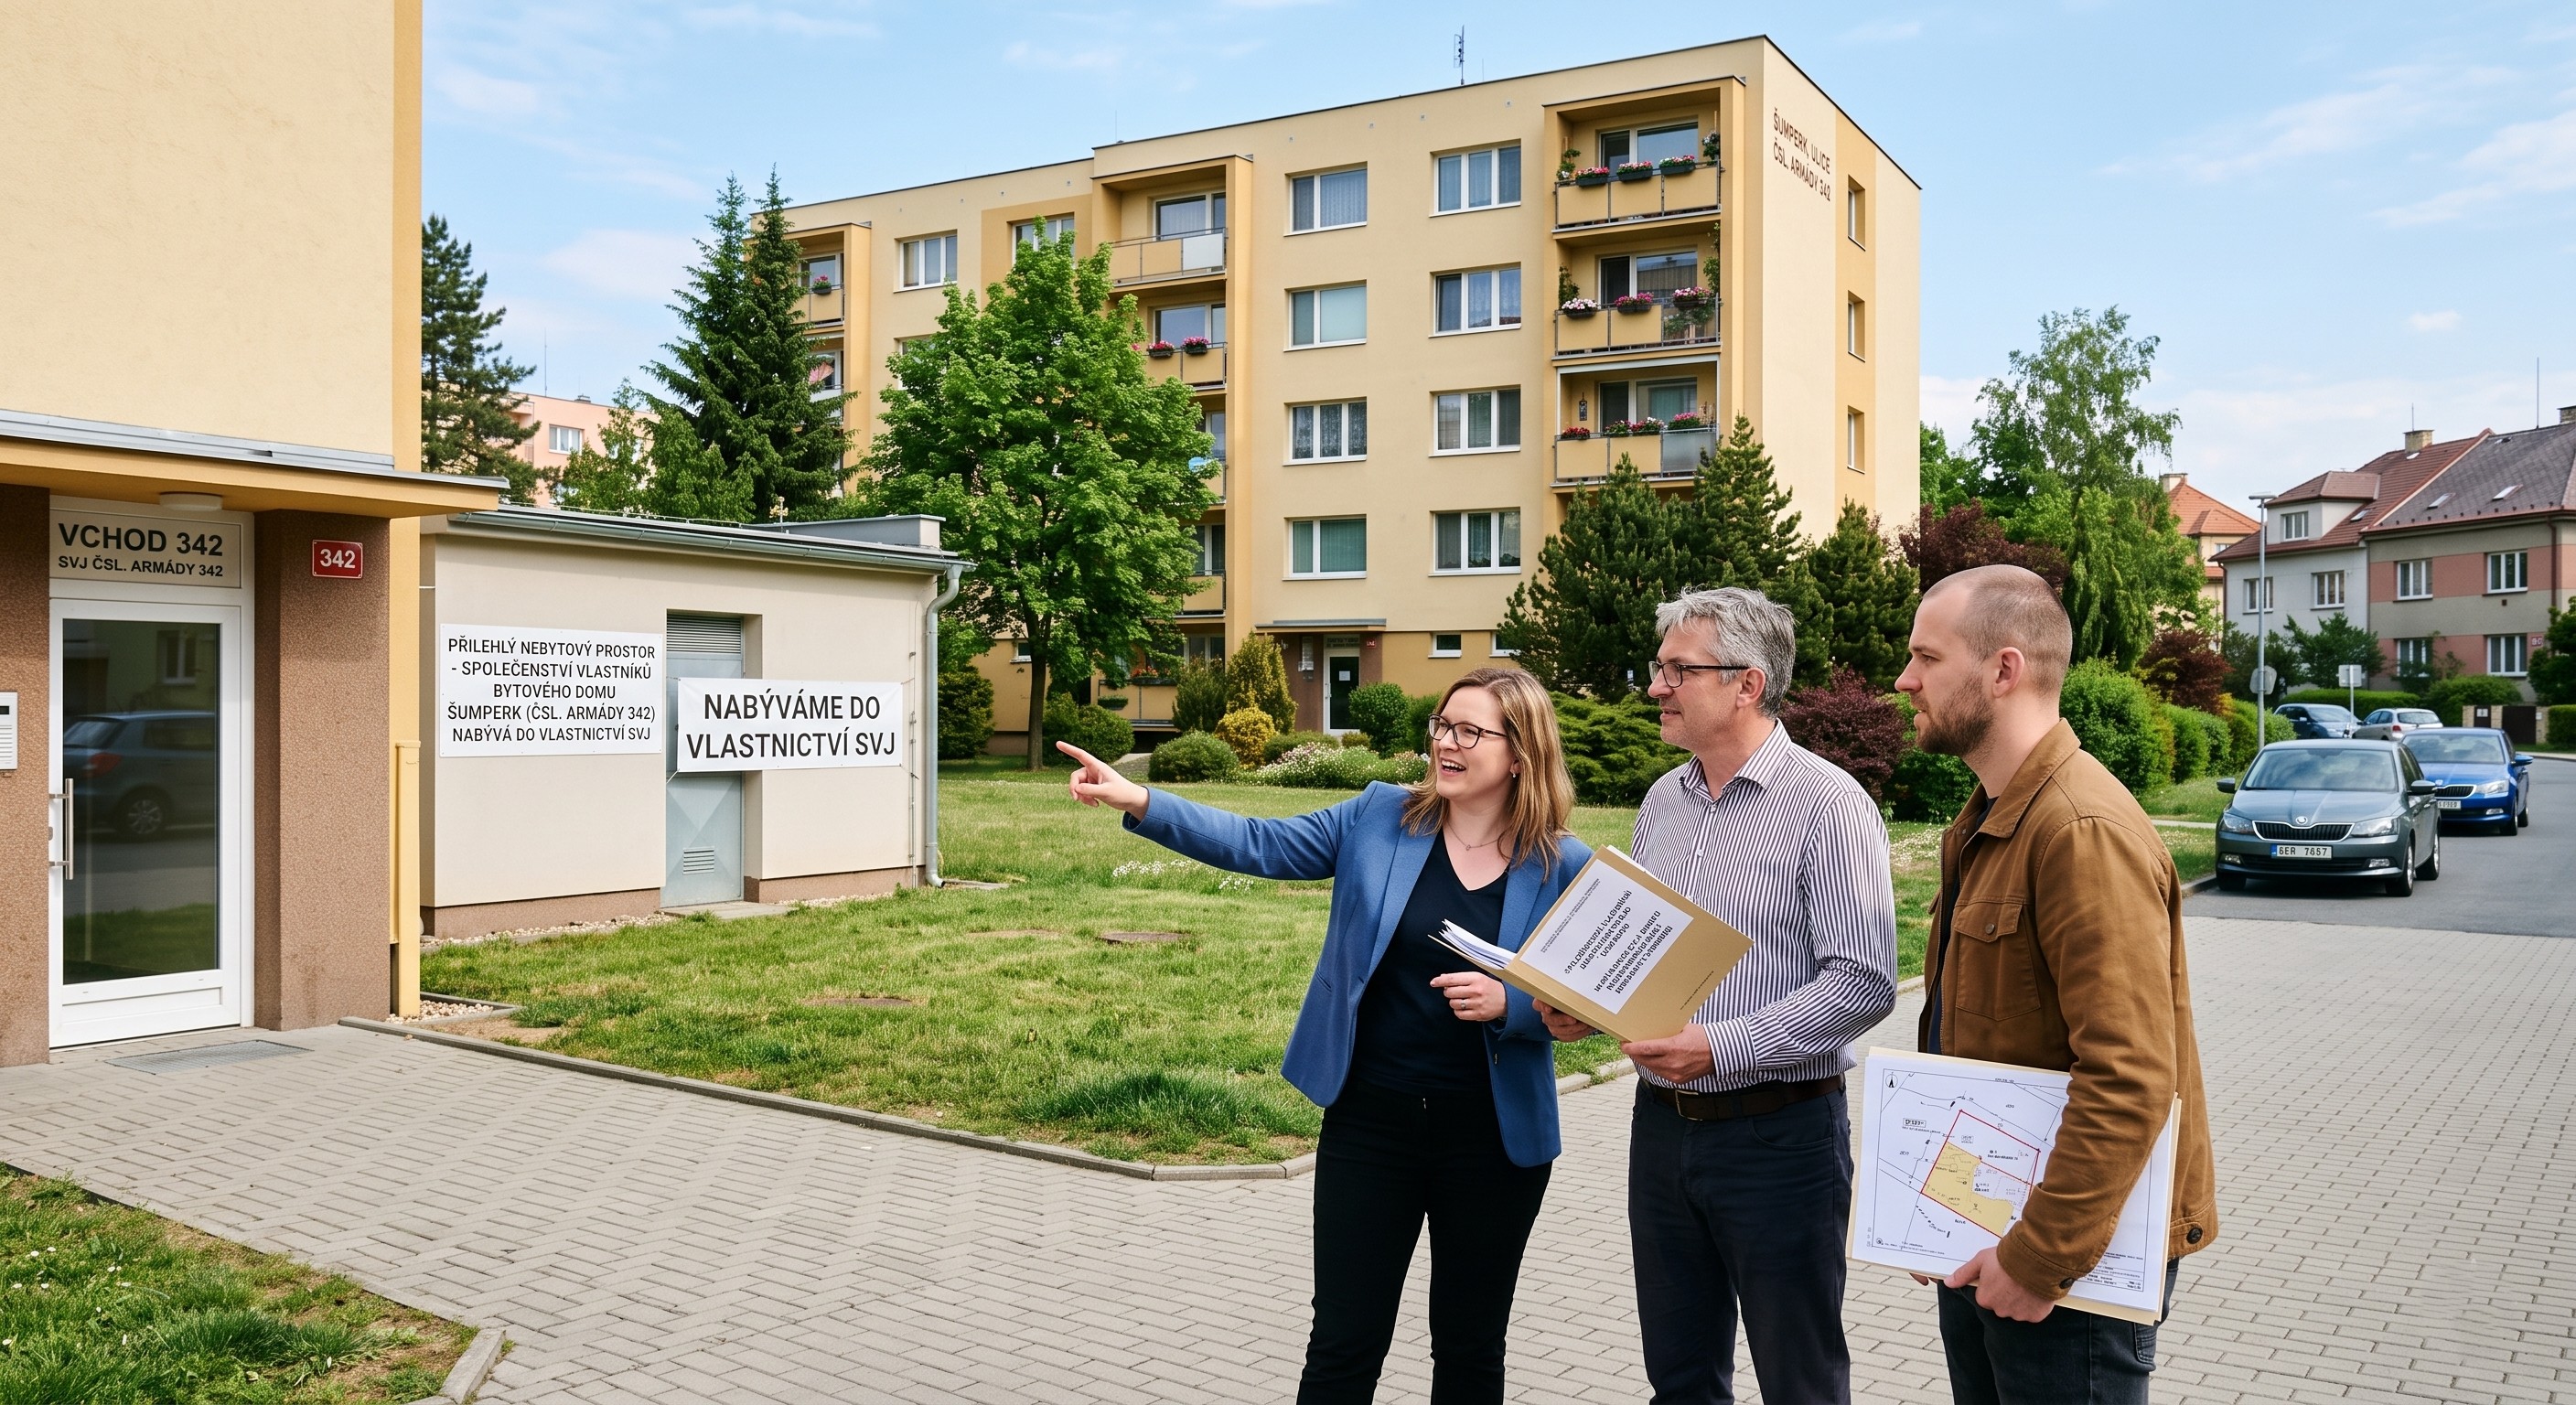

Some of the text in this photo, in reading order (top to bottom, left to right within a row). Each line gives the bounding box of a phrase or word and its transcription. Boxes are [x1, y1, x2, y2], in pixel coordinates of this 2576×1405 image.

[1774, 107, 1830, 175] ŠUMPERK, ULICE
[1774, 136, 1830, 202] ČSL. ARMÁDY 342
[59, 523, 223, 557] VCHOD 342
[58, 554, 223, 577] SVJ ČSL. ARMÁDY 342
[320, 549, 356, 569] 342
[448, 635, 656, 660] PŘILEHLÝ NEBYTOVÝ PROSTOR
[461, 659, 574, 678] SPOLEČENSTVÍ
[576, 662, 652, 680] VLASTNÍKŮ
[493, 681, 616, 699] BYTOVÉHO DOMU
[447, 702, 522, 720] ŠUMPERK
[566, 702, 625, 720] ARMÁDY
[628, 705, 656, 724] 342)
[704, 688, 881, 721] NABÝVÁME DO
[453, 724, 650, 743] NABÝVÁ DO VLASTNICTVÍ SVJ
[686, 726, 896, 760] VLASTNICTVÍ SVJ
[2279, 846, 2296, 855] 6ER
